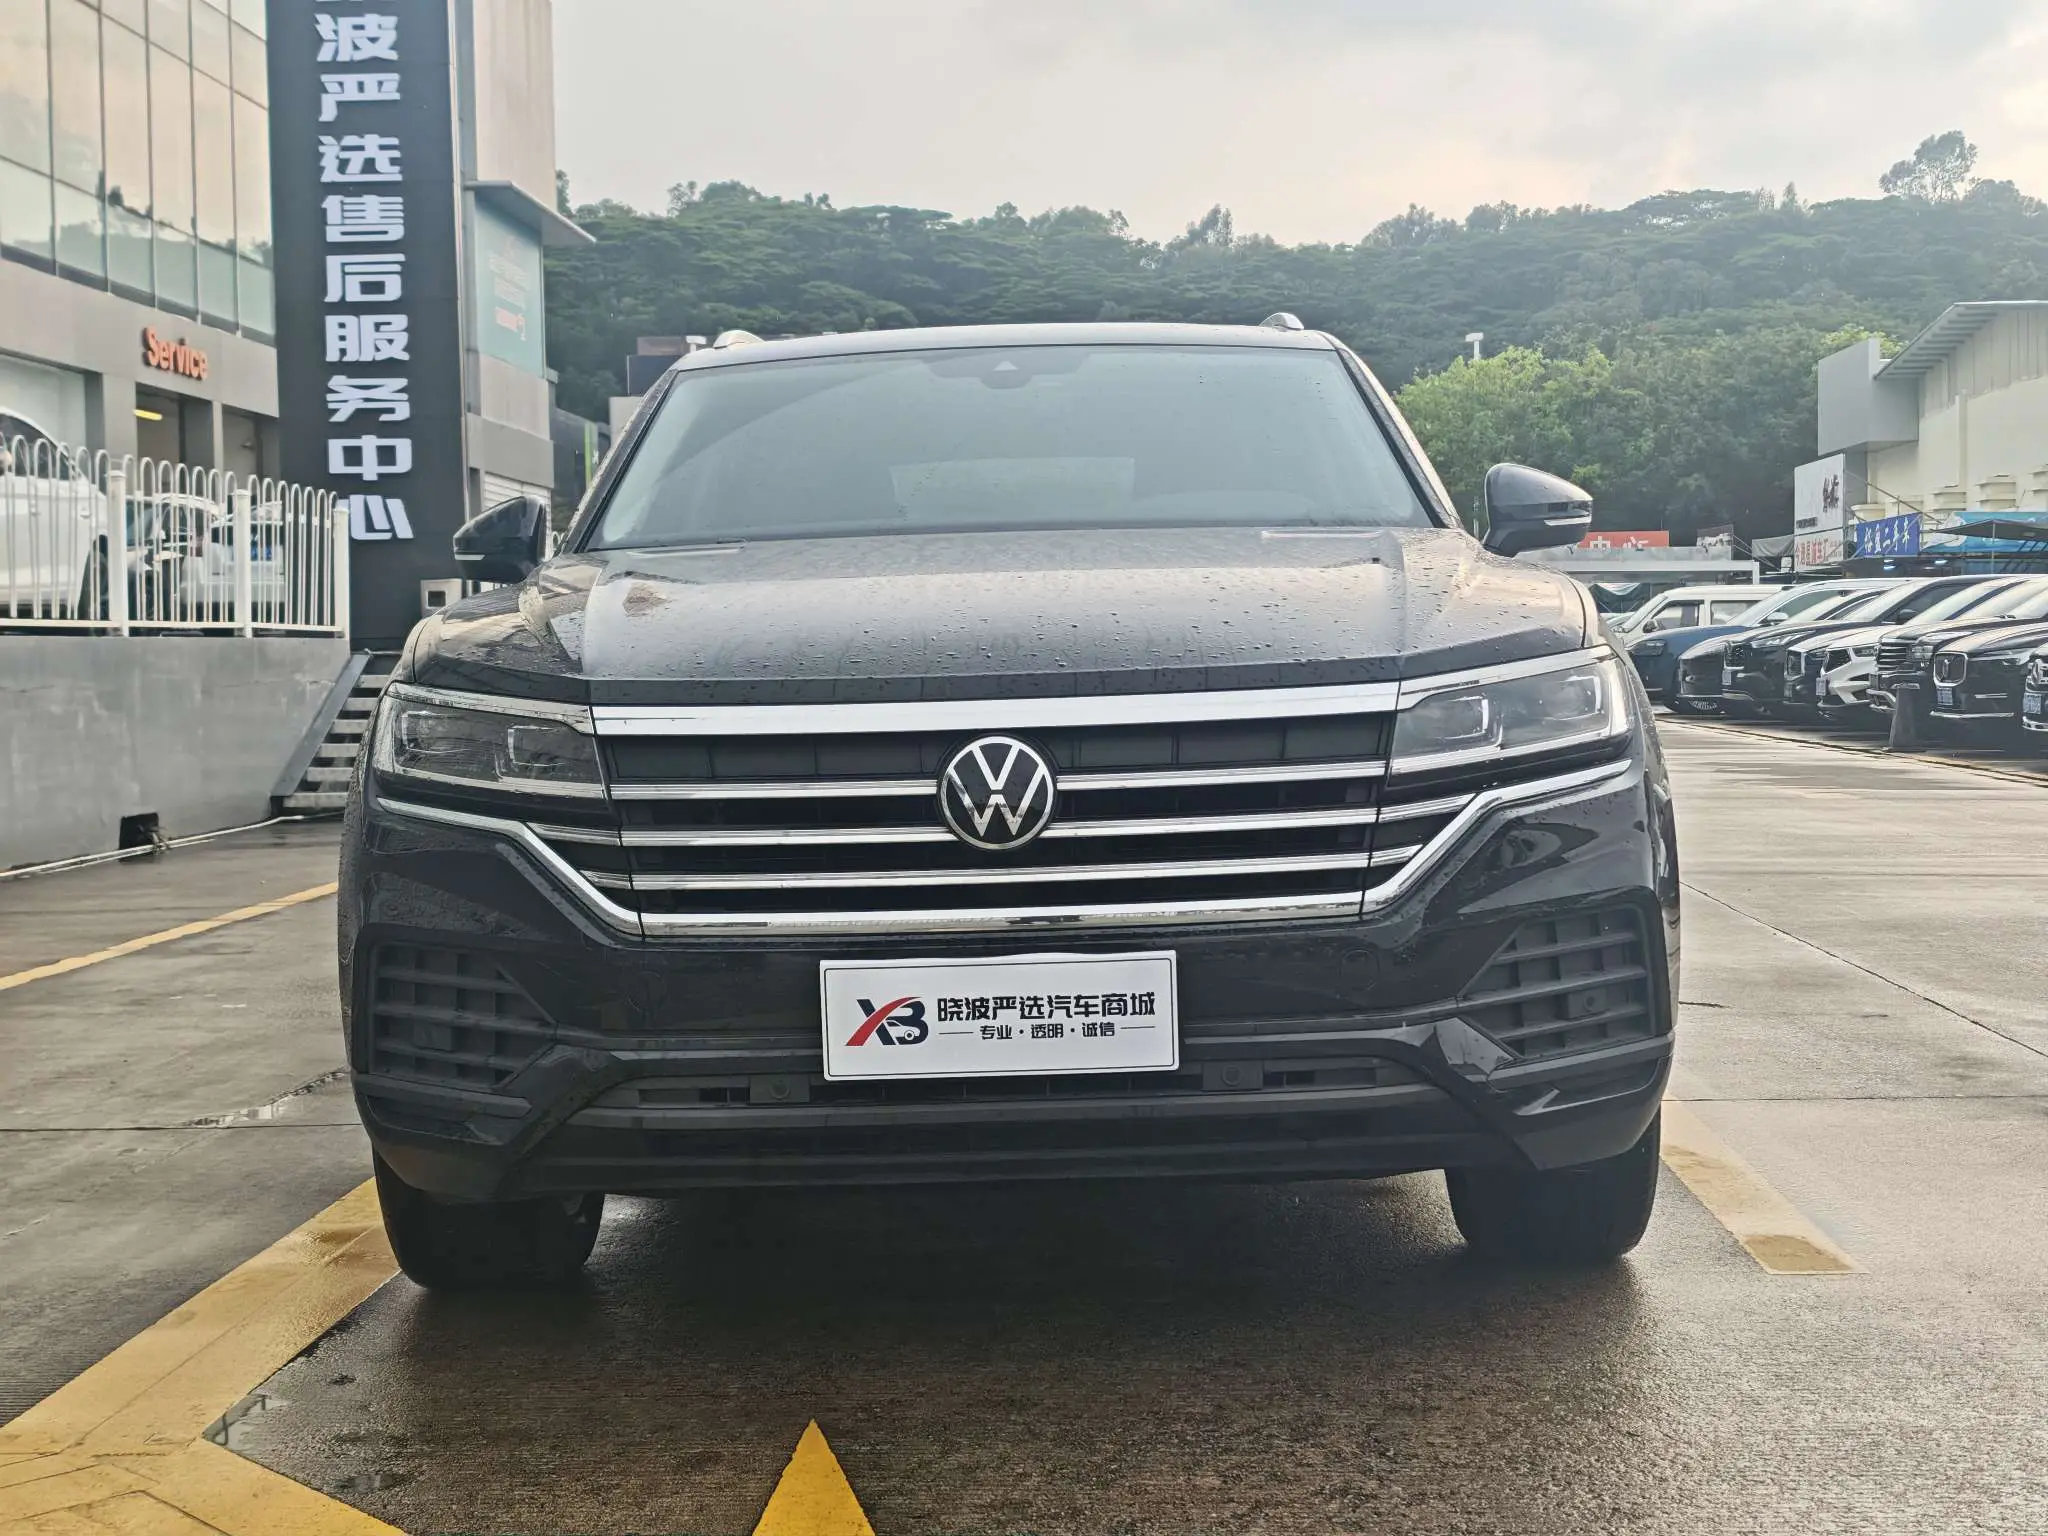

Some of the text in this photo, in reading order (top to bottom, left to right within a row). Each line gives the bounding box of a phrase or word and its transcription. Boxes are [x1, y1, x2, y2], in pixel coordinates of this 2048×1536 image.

[313, 0, 414, 540] 波严选售后服务中心
[143, 325, 208, 380] Service
[937, 991, 1156, 1022] 晓波严选汽车商城
